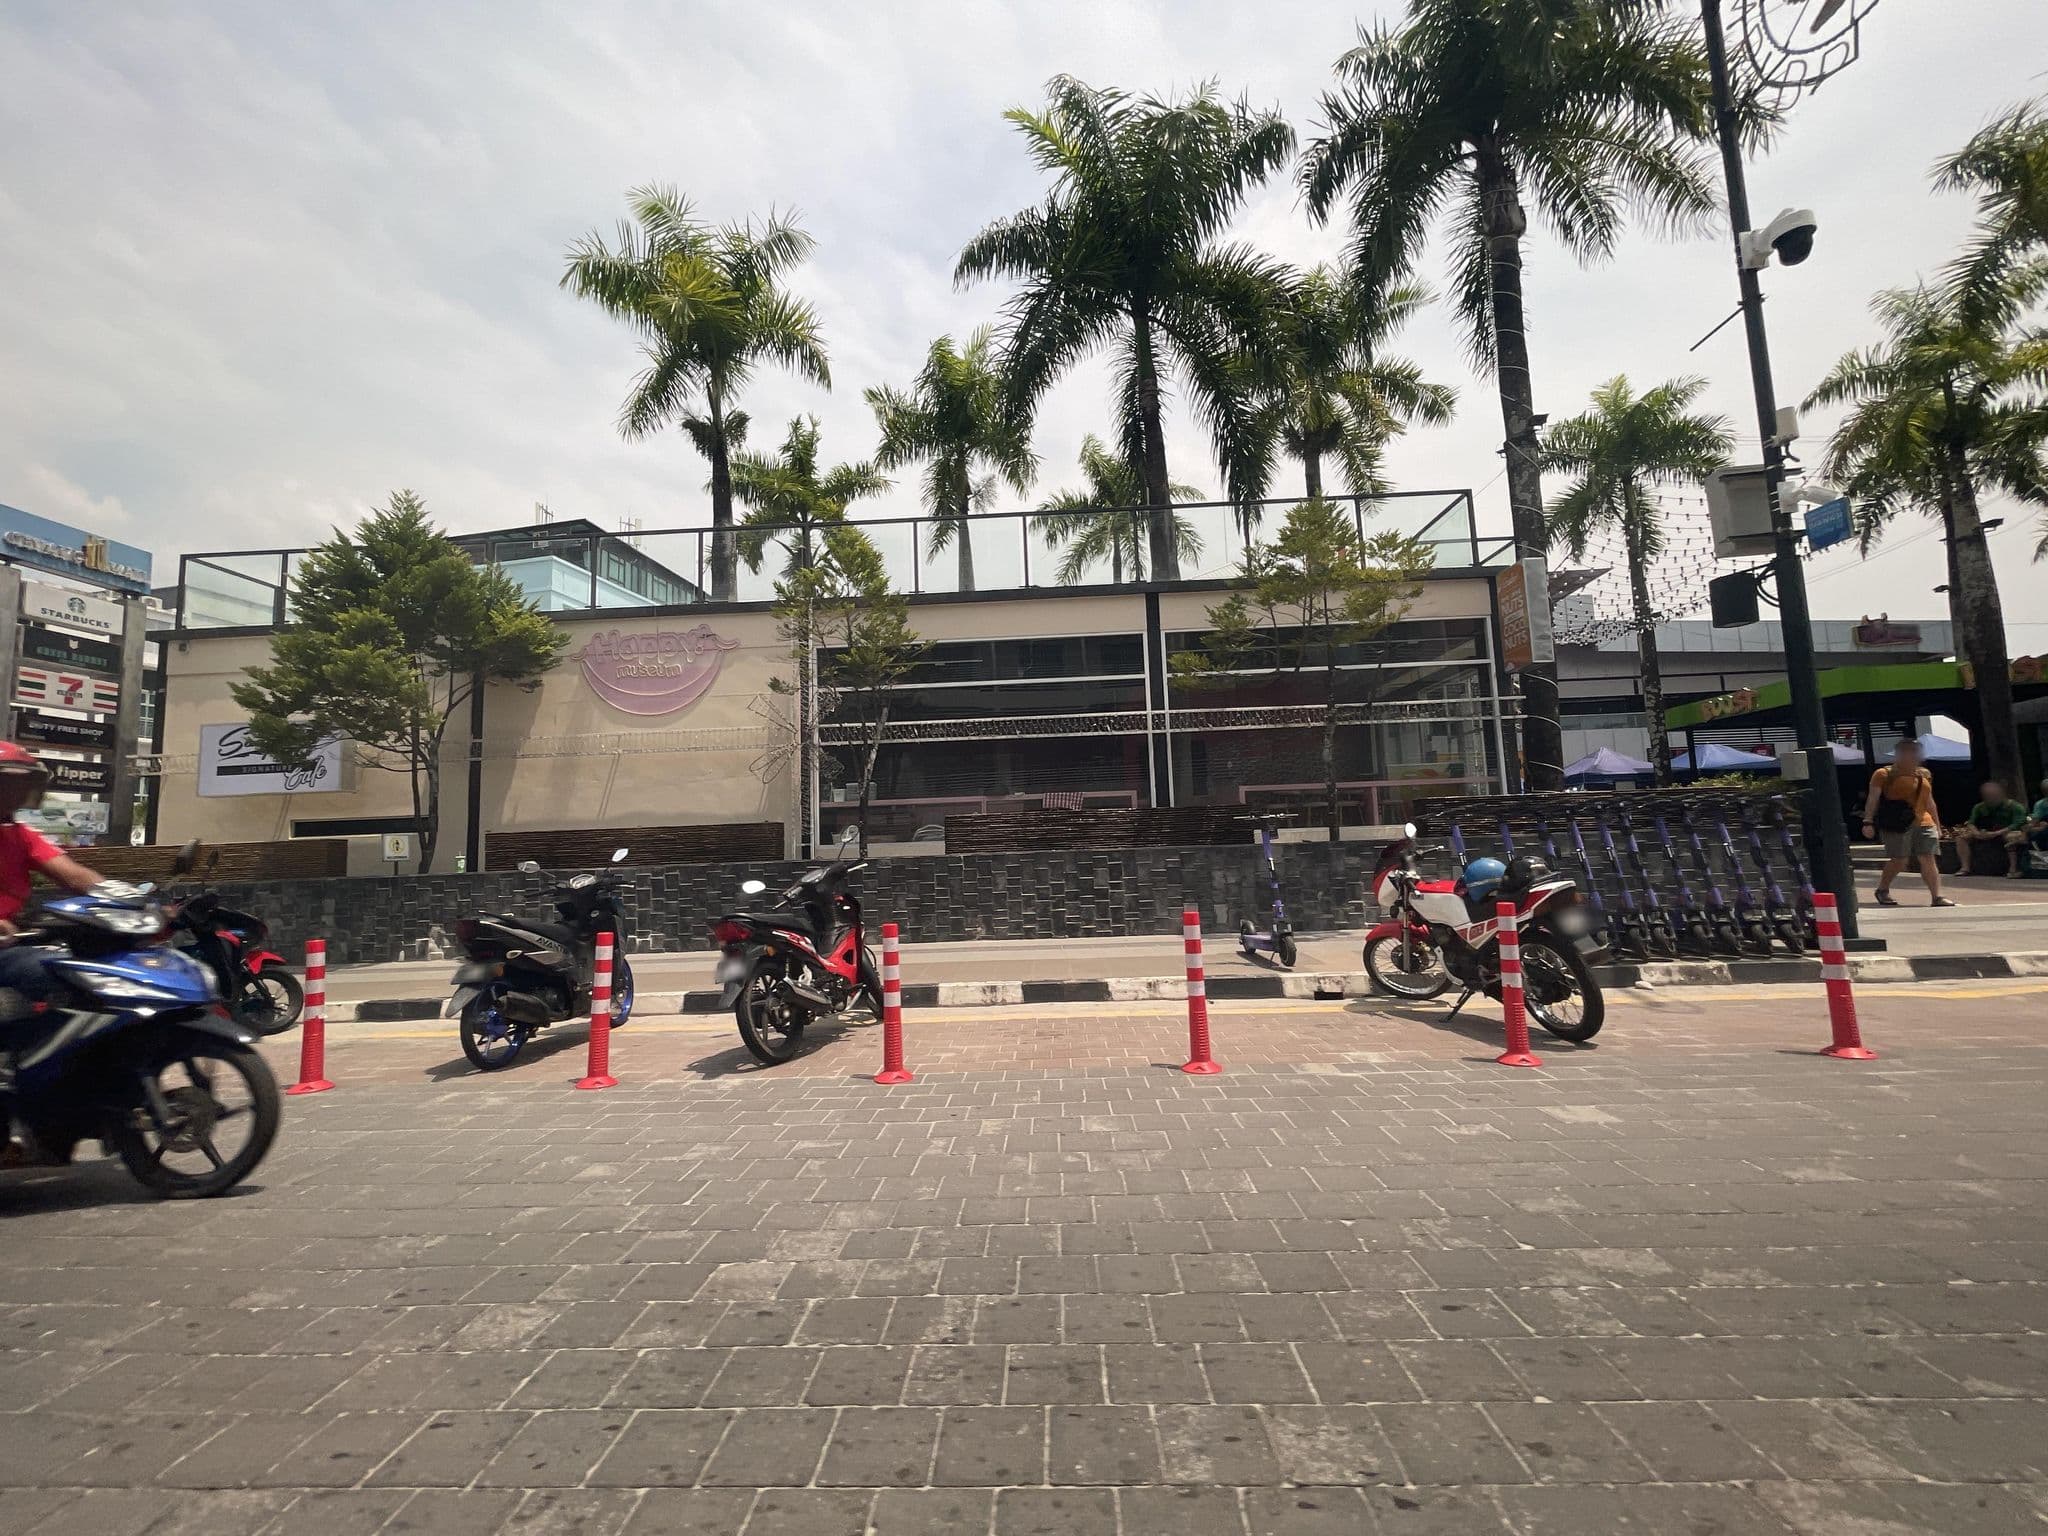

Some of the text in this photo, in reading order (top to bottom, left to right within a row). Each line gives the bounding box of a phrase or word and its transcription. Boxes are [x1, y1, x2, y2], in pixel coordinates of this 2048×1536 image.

[40, 607, 110, 629] STARBUCKS
[57, 725, 79, 734] FREE
[242, 764, 292, 774] SIGNATURE
